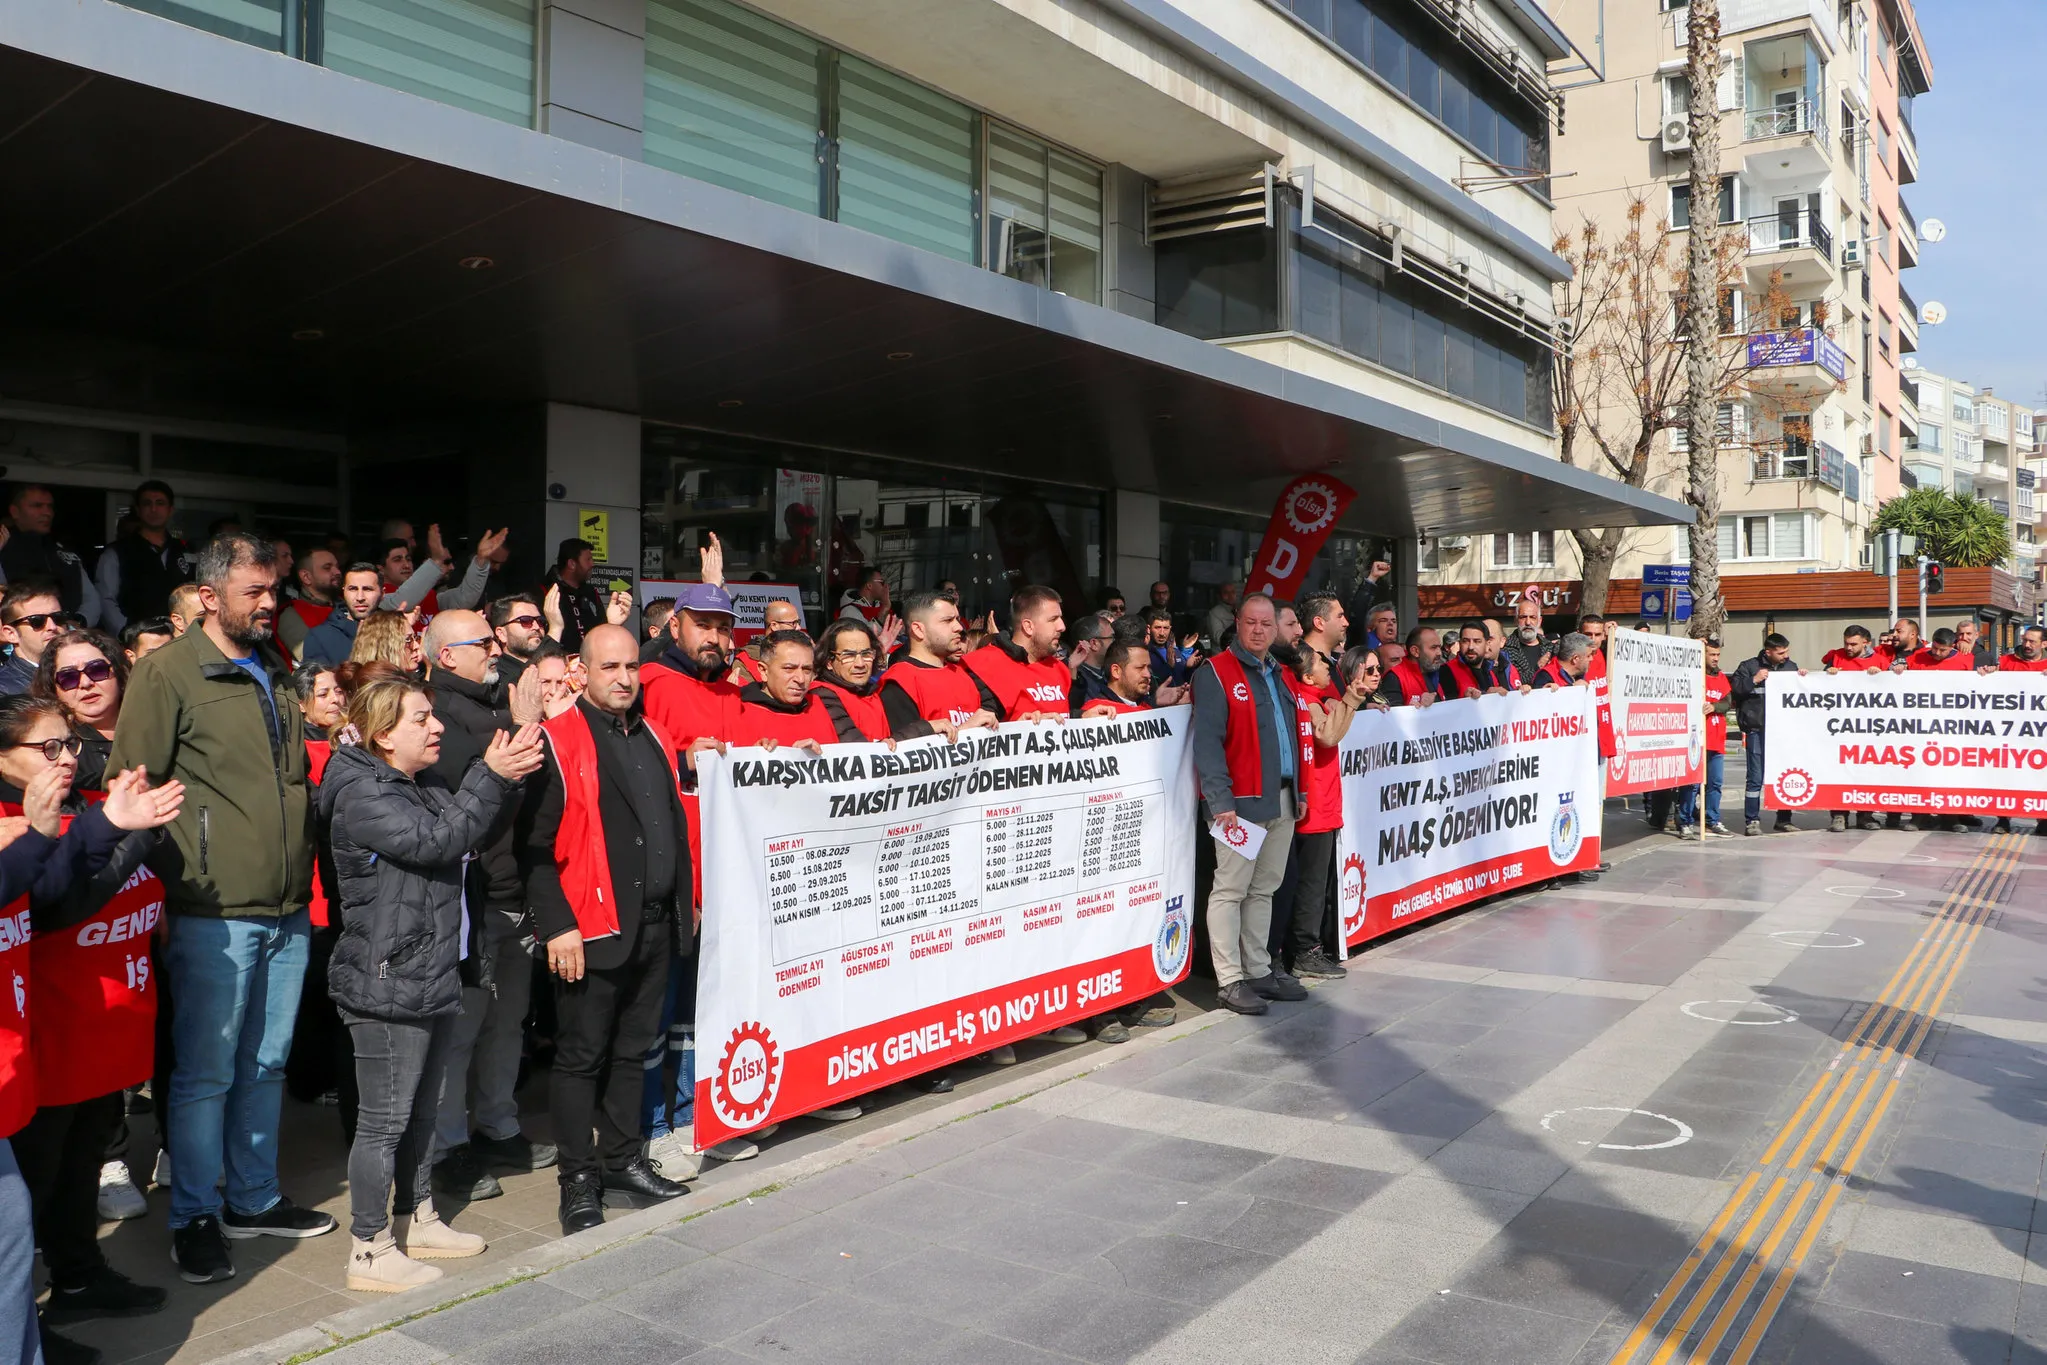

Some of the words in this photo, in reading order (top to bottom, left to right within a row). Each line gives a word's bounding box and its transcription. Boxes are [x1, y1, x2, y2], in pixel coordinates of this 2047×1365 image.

[1297, 496, 1325, 517] DİSK
[1026, 682, 1066, 702] DİSK
[1782, 692, 1898, 713] KARŞIYAKA
[1903, 690, 2024, 710] BELEDİYESİ
[2030, 695, 2047, 711] K
[1827, 718, 1996, 736] ÇALIŞANLARINA
[2002, 721, 2014, 736] 7
[1401, 731, 1452, 765] BELEDİYE
[1512, 718, 1549, 743] YILDIZ
[732, 755, 867, 790] KARŞIYAKA
[871, 736, 974, 778] BELEDİYESİ
[977, 731, 1022, 760] KENT
[1025, 729, 1060, 756] A.Ş.
[1062, 718, 1172, 755] ÇALIŞANLARINA
[1839, 745, 1916, 769] MAAŞ
[1922, 741, 2047, 770] ÖDEMİYO
[829, 783, 904, 818] TAKSİT
[906, 772, 966, 808] TAKSİT
[967, 764, 1044, 794] ÖDENEN
[1048, 756, 1121, 785] MAAŞLAR
[1380, 780, 1421, 812] KENT
[1422, 776, 1451, 805] A.Ş.
[1452, 753, 1539, 798] EMEKÇİLERİNE
[1785, 779, 1805, 789] DİSK
[986, 808, 1010, 817] MAYIS
[1011, 806, 1021, 814] AYI
[1842, 790, 1876, 805] DİSK
[1878, 792, 1944, 808] GENEL-İŞ
[1946, 795, 1961, 807] 10
[1996, 798, 2016, 810] LU
[2023, 798, 2047, 812] ŞU
[911, 823, 922, 833] AYI
[1378, 818, 1437, 865] MAAŞ
[1440, 792, 1538, 848] ÖDEMİYOR!
[769, 841, 789, 853] MART
[792, 838, 804, 849] AYI
[880, 889, 899, 900] 5.000
[911, 879, 951, 894] 31.10.2025
[986, 881, 1008, 892] KALAN
[1011, 876, 1028, 886] KISIM
[1128, 884, 1147, 895] OCAK
[1148, 880, 1158, 890] AYI
[1392, 899, 1412, 919] DİSK
[1411, 885, 1442, 911] GENEL-İŞ
[1442, 878, 1464, 900] İZMİR
[1464, 877, 1474, 891] 10
[1490, 869, 1499, 885] LU
[1502, 862, 1523, 881] ŞUBE
[773, 898, 797, 911] 10.500
[808, 886, 848, 902] 05.09.2025
[880, 902, 905, 914] 12.000
[916, 891, 956, 906] 07.11.2025
[1076, 894, 1101, 906] ARALIK
[1103, 890, 1115, 900] AYI
[1128, 891, 1162, 907] ÖDENMEDİ
[774, 912, 797, 926] KALAN
[800, 906, 820, 919] KISIM
[832, 895, 871, 911] 12.09.2025
[881, 915, 905, 927] KALAN
[907, 910, 927, 921] KISIM
[939, 899, 978, 914] 14.11.2025
[1023, 906, 1047, 919] KASIM
[1049, 902, 1061, 913] AYI
[1076, 902, 1114, 919] ÖDENMEDİ
[968, 918, 988, 932] EKİM
[990, 915, 1002, 926] AYI
[1023, 915, 1063, 932] ÖDENMEDİ
[911, 930, 936, 945] EYLÜL
[938, 928, 952, 938] AYI
[965, 928, 1005, 946] ÖDENMEDİ
[841, 945, 878, 963] AĞUSTOS
[880, 941, 893, 952] AYI
[910, 940, 952, 960] ÖDENMEDİ
[126, 954, 148, 992] İŞ
[776, 963, 808, 983] TEMMUZ
[810, 959, 824, 971] AYI
[846, 956, 890, 978] ÖDENMEDİ
[779, 974, 821, 997] ÖDENMEDİ
[826, 1042, 880, 1086] DİSK
[883, 1011, 976, 1066] GENEL-İŞ
[980, 1007, 1001, 1035] 10
[1043, 986, 1068, 1015] LU
[1076, 969, 1122, 1008] ŞUBE
[731, 1056, 765, 1085] DİSK
